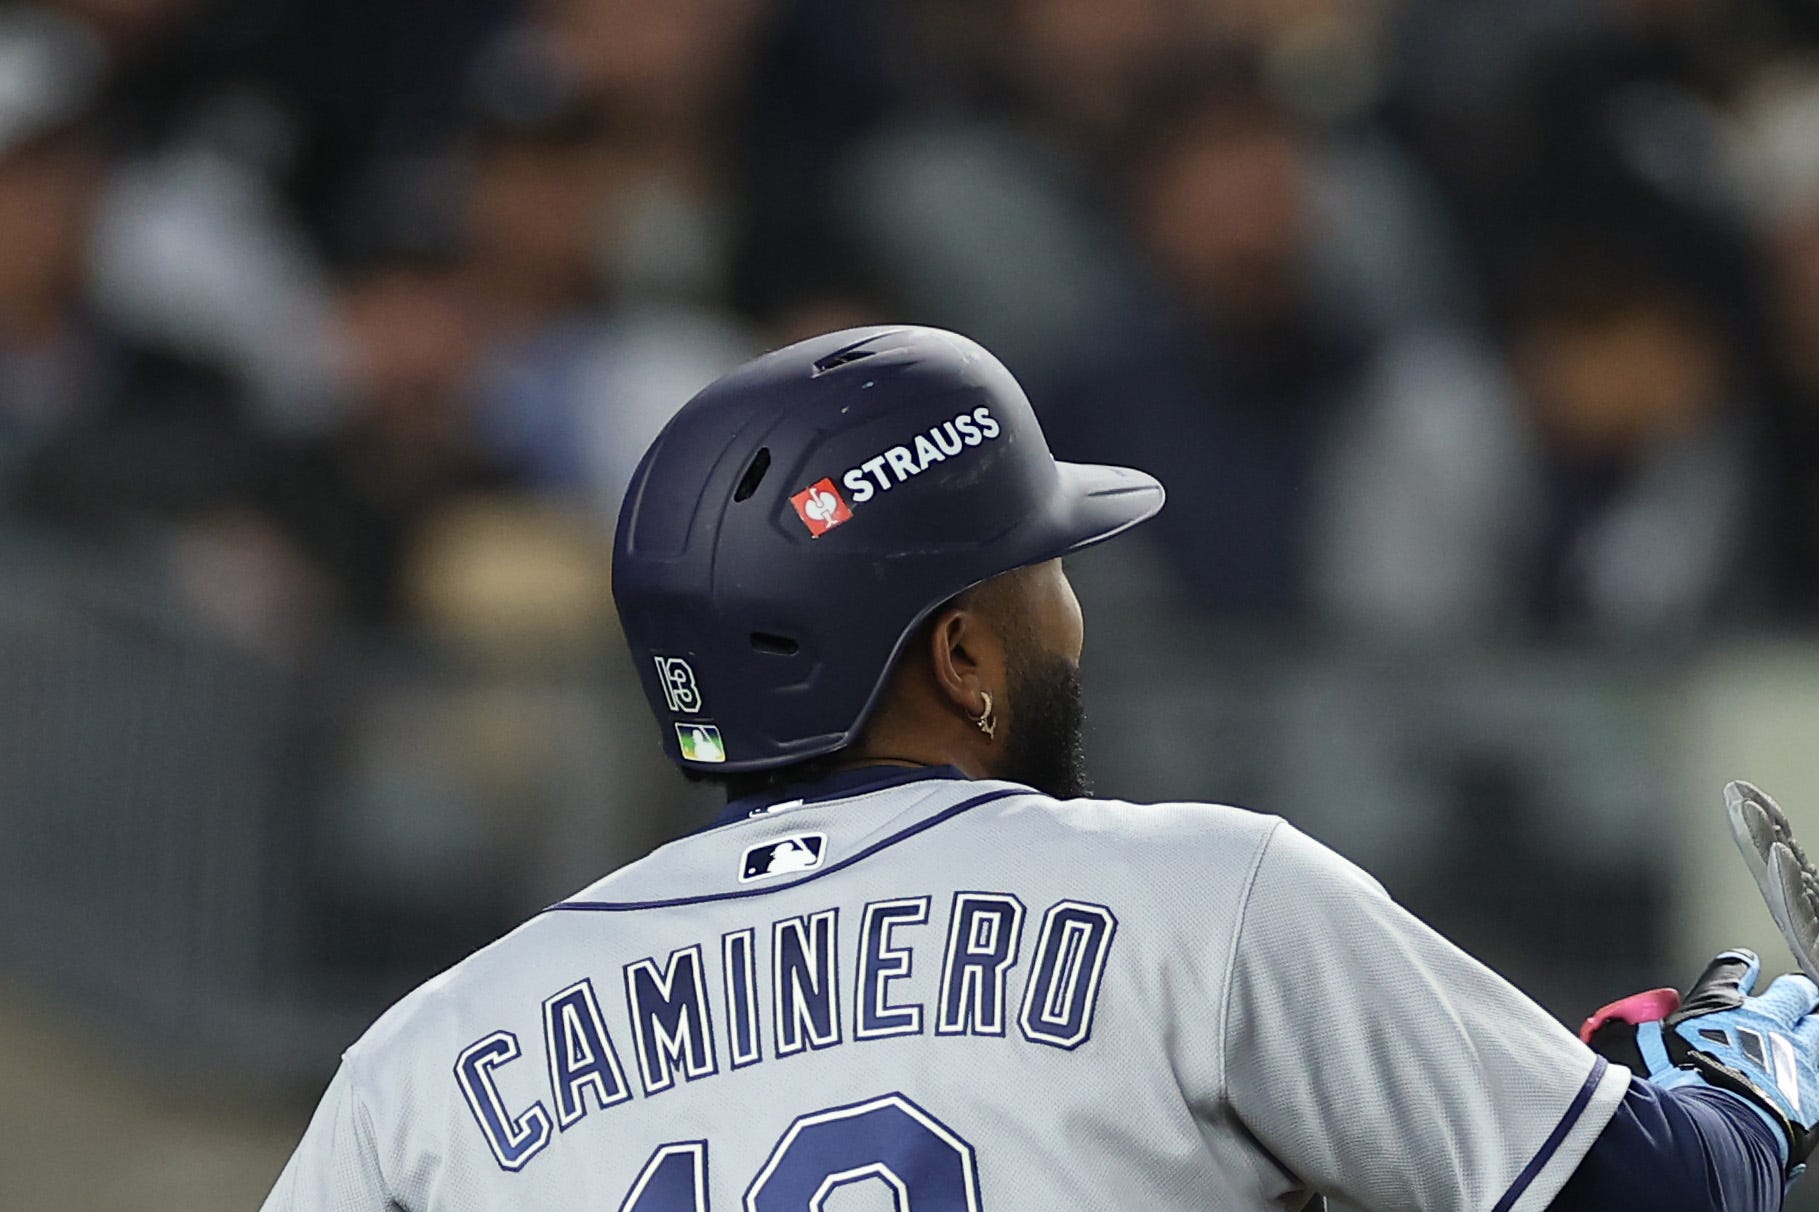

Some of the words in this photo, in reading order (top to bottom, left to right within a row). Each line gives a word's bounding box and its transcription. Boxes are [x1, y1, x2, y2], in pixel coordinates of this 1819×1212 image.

[844, 406, 1001, 504] STRAUSS
[654, 656, 702, 713] 13
[453, 891, 1118, 1171] CAMINERO
